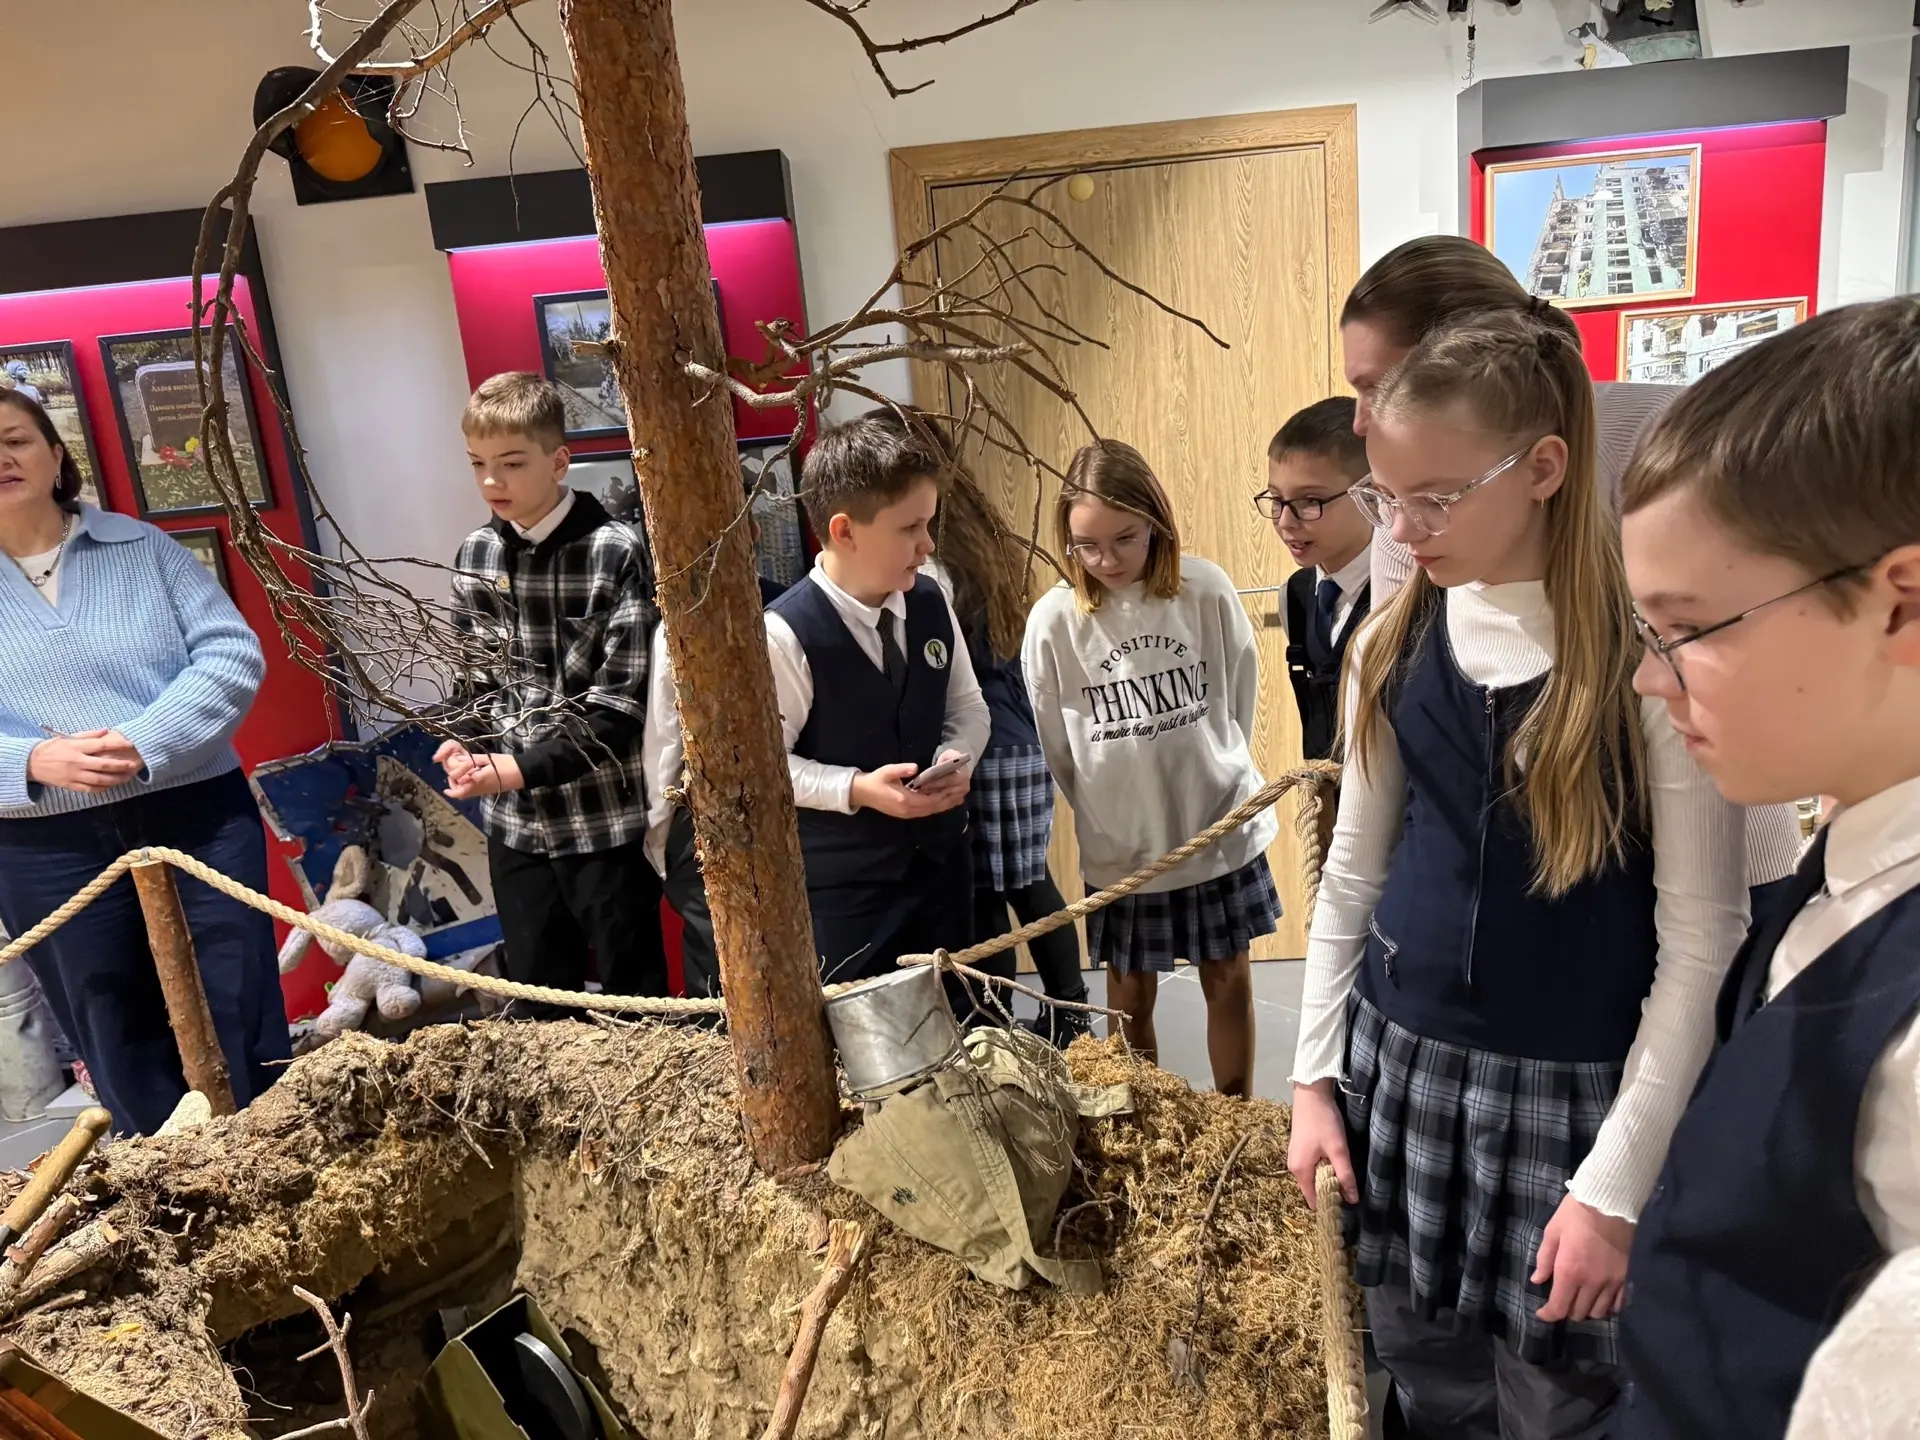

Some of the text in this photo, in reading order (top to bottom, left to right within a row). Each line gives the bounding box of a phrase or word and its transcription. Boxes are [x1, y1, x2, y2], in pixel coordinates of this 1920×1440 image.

[1100, 634, 1188, 673] POSITIVE
[1081, 660, 1209, 725] THINKING
[1091, 730, 1102, 742] is
[1103, 727, 1131, 741] more
[1132, 722, 1154, 738] than
[1148, 715, 1178, 741] just
[1179, 715, 1187, 726] a
